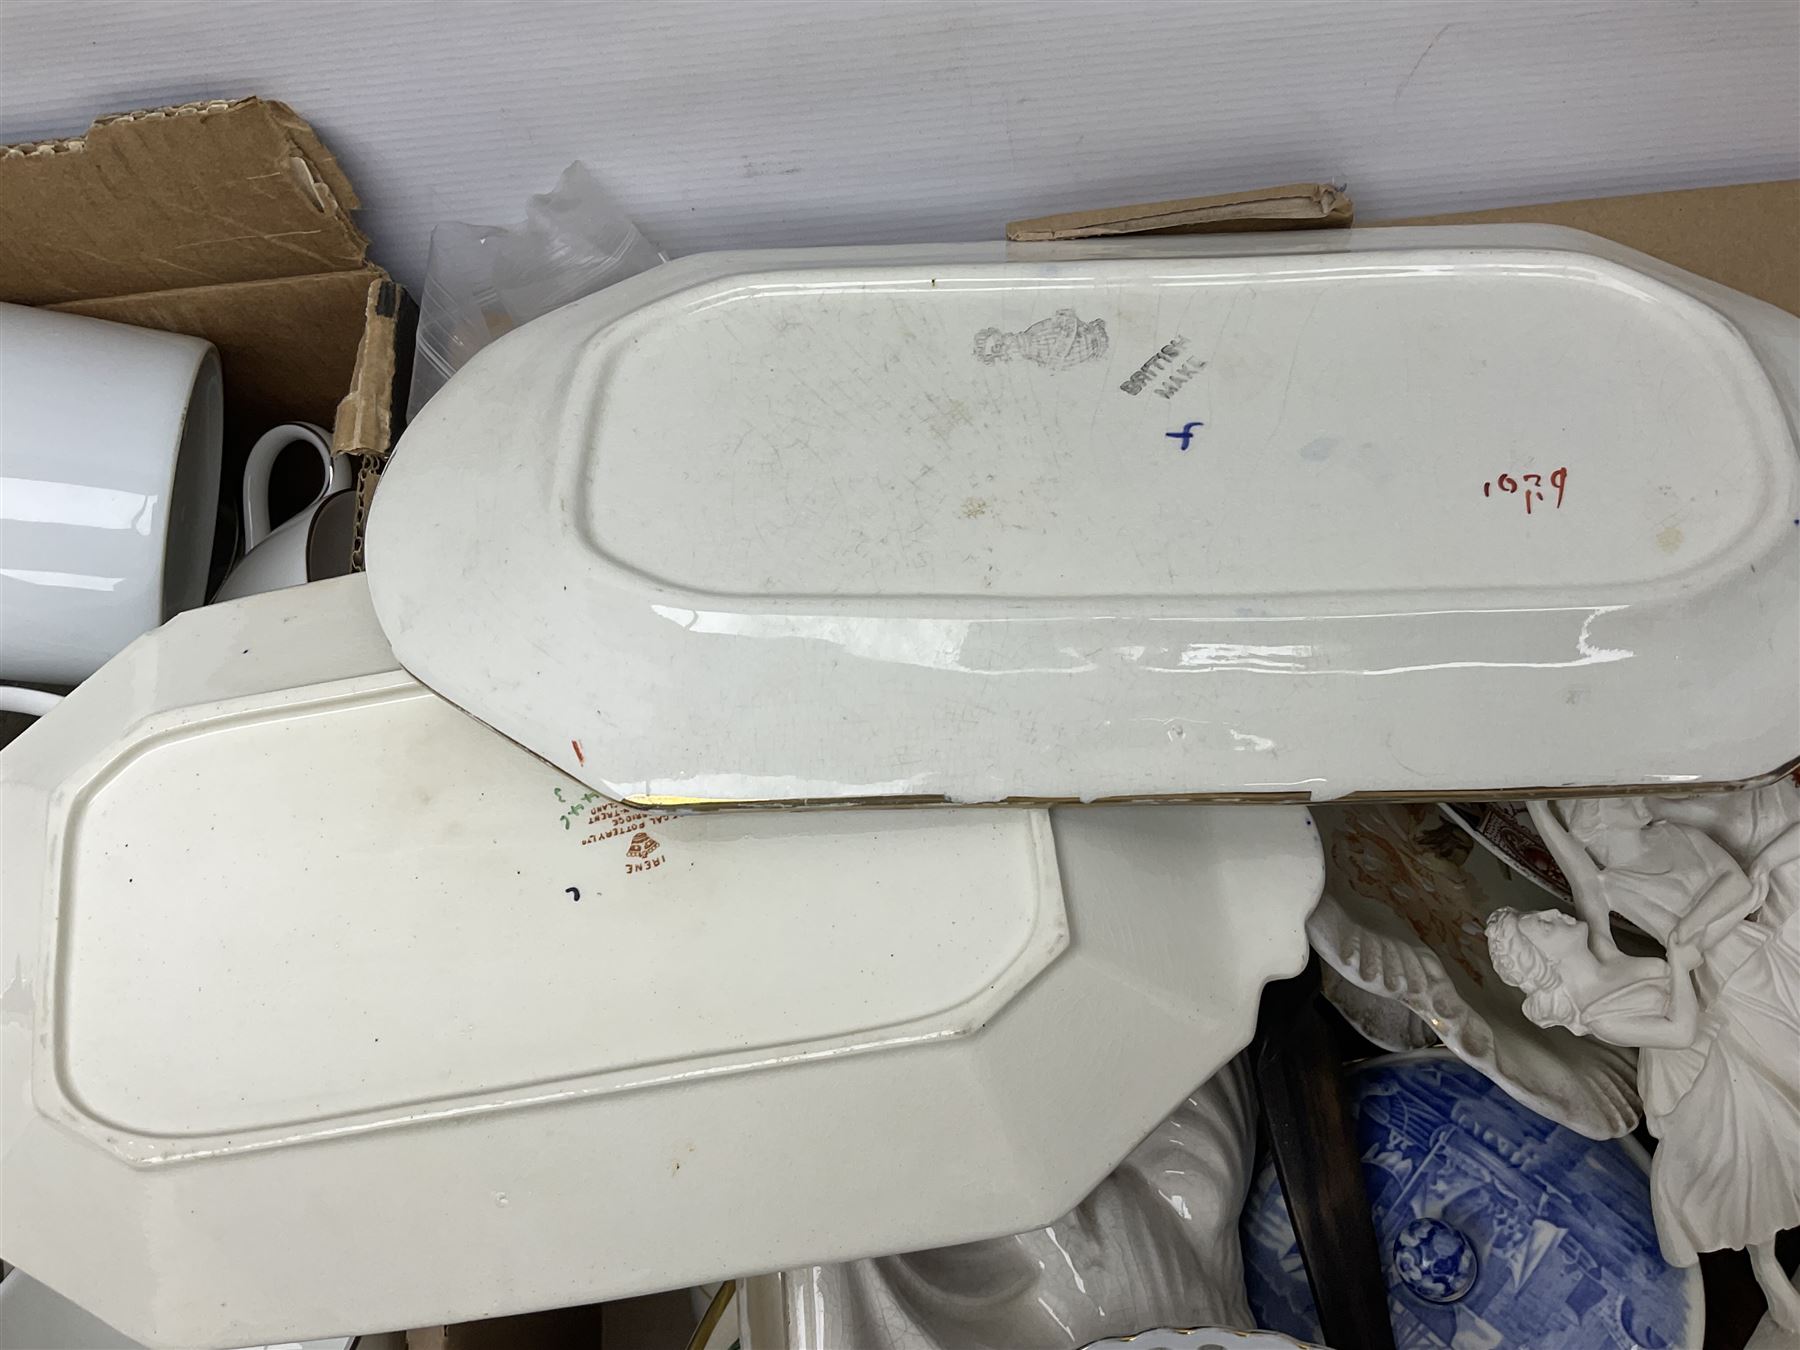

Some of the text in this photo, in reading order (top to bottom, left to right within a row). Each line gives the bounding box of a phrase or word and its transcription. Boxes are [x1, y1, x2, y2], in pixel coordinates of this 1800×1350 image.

[1120, 335, 1190, 396] BRITISH
[1154, 355, 1206, 399] MAKE
[650, 814, 683, 825] GAL
[598, 822, 645, 841] POTTERY
[625, 855, 666, 874] IRENE
